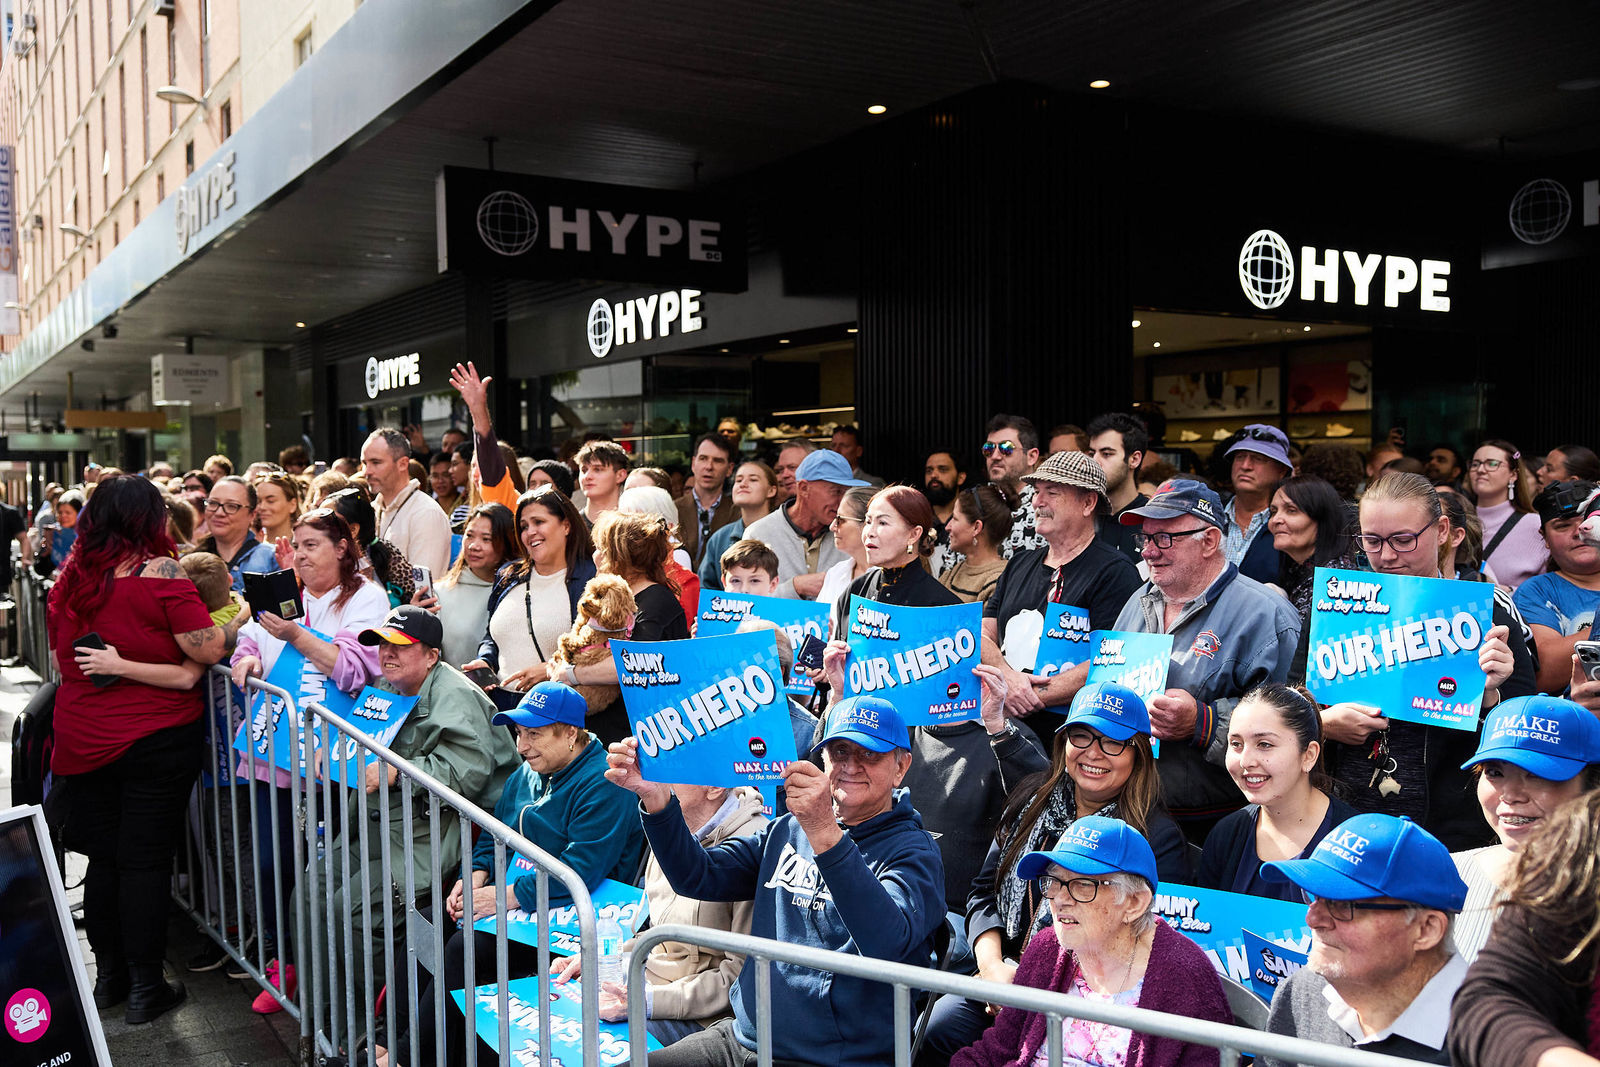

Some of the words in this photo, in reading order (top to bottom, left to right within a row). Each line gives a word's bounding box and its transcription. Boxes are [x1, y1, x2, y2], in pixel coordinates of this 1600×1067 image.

[189, 150, 237, 236] HYPE
[549, 206, 722, 262] HYPE
[1301, 246, 1450, 312] HYPE
[614, 289, 703, 346] HYPE
[379, 352, 420, 391] HYPE
[1327, 580, 1382, 601] SAMMY
[711, 598, 754, 614] SAMMY
[1317, 599, 1332, 611] Our
[1334, 600, 1352, 613] Boy
[1353, 602, 1364, 612] in
[1365, 601, 1390, 614] Blue
[857, 606, 890, 629] SAMMY
[781, 620, 822, 650] RO
[879, 626, 900, 640] Blue
[1064, 630, 1082, 642] Boy
[1316, 634, 1381, 680] OUR
[1380, 611, 1482, 667] HERO
[622, 652, 664, 673] SAMMY
[849, 657, 897, 694] OUR
[893, 628, 975, 684] HERO
[633, 673, 648, 687] Boy
[648, 674, 657, 684] in
[657, 672, 680, 684] Blue
[804, 679, 816, 687] AL
[635, 707, 694, 757] OUR
[680, 665, 775, 736] HERO
[929, 702, 952, 714] MAX
[960, 699, 977, 710] ALI
[1103, 704, 1123, 716] GREAT
[1412, 696, 1443, 711] MAX
[1445, 703, 1452, 711] &
[1453, 703, 1475, 716] ALI
[1430, 711, 1441, 719] the
[1493, 717, 1501, 731] I
[1501, 714, 1560, 735] MAKE
[1506, 729, 1529, 737] CARE
[1530, 731, 1560, 744] GREAT
[734, 761, 762, 773] MAX
[1073, 838, 1099, 850] GREAT
[515, 857, 533, 871] ALI
[1331, 846, 1363, 866] GREAT
[1151, 894, 1199, 917] MMY
[1181, 916, 1211, 932] Blue
[1255, 968, 1275, 985] Our
[50, 1051, 72, 1067] AND
